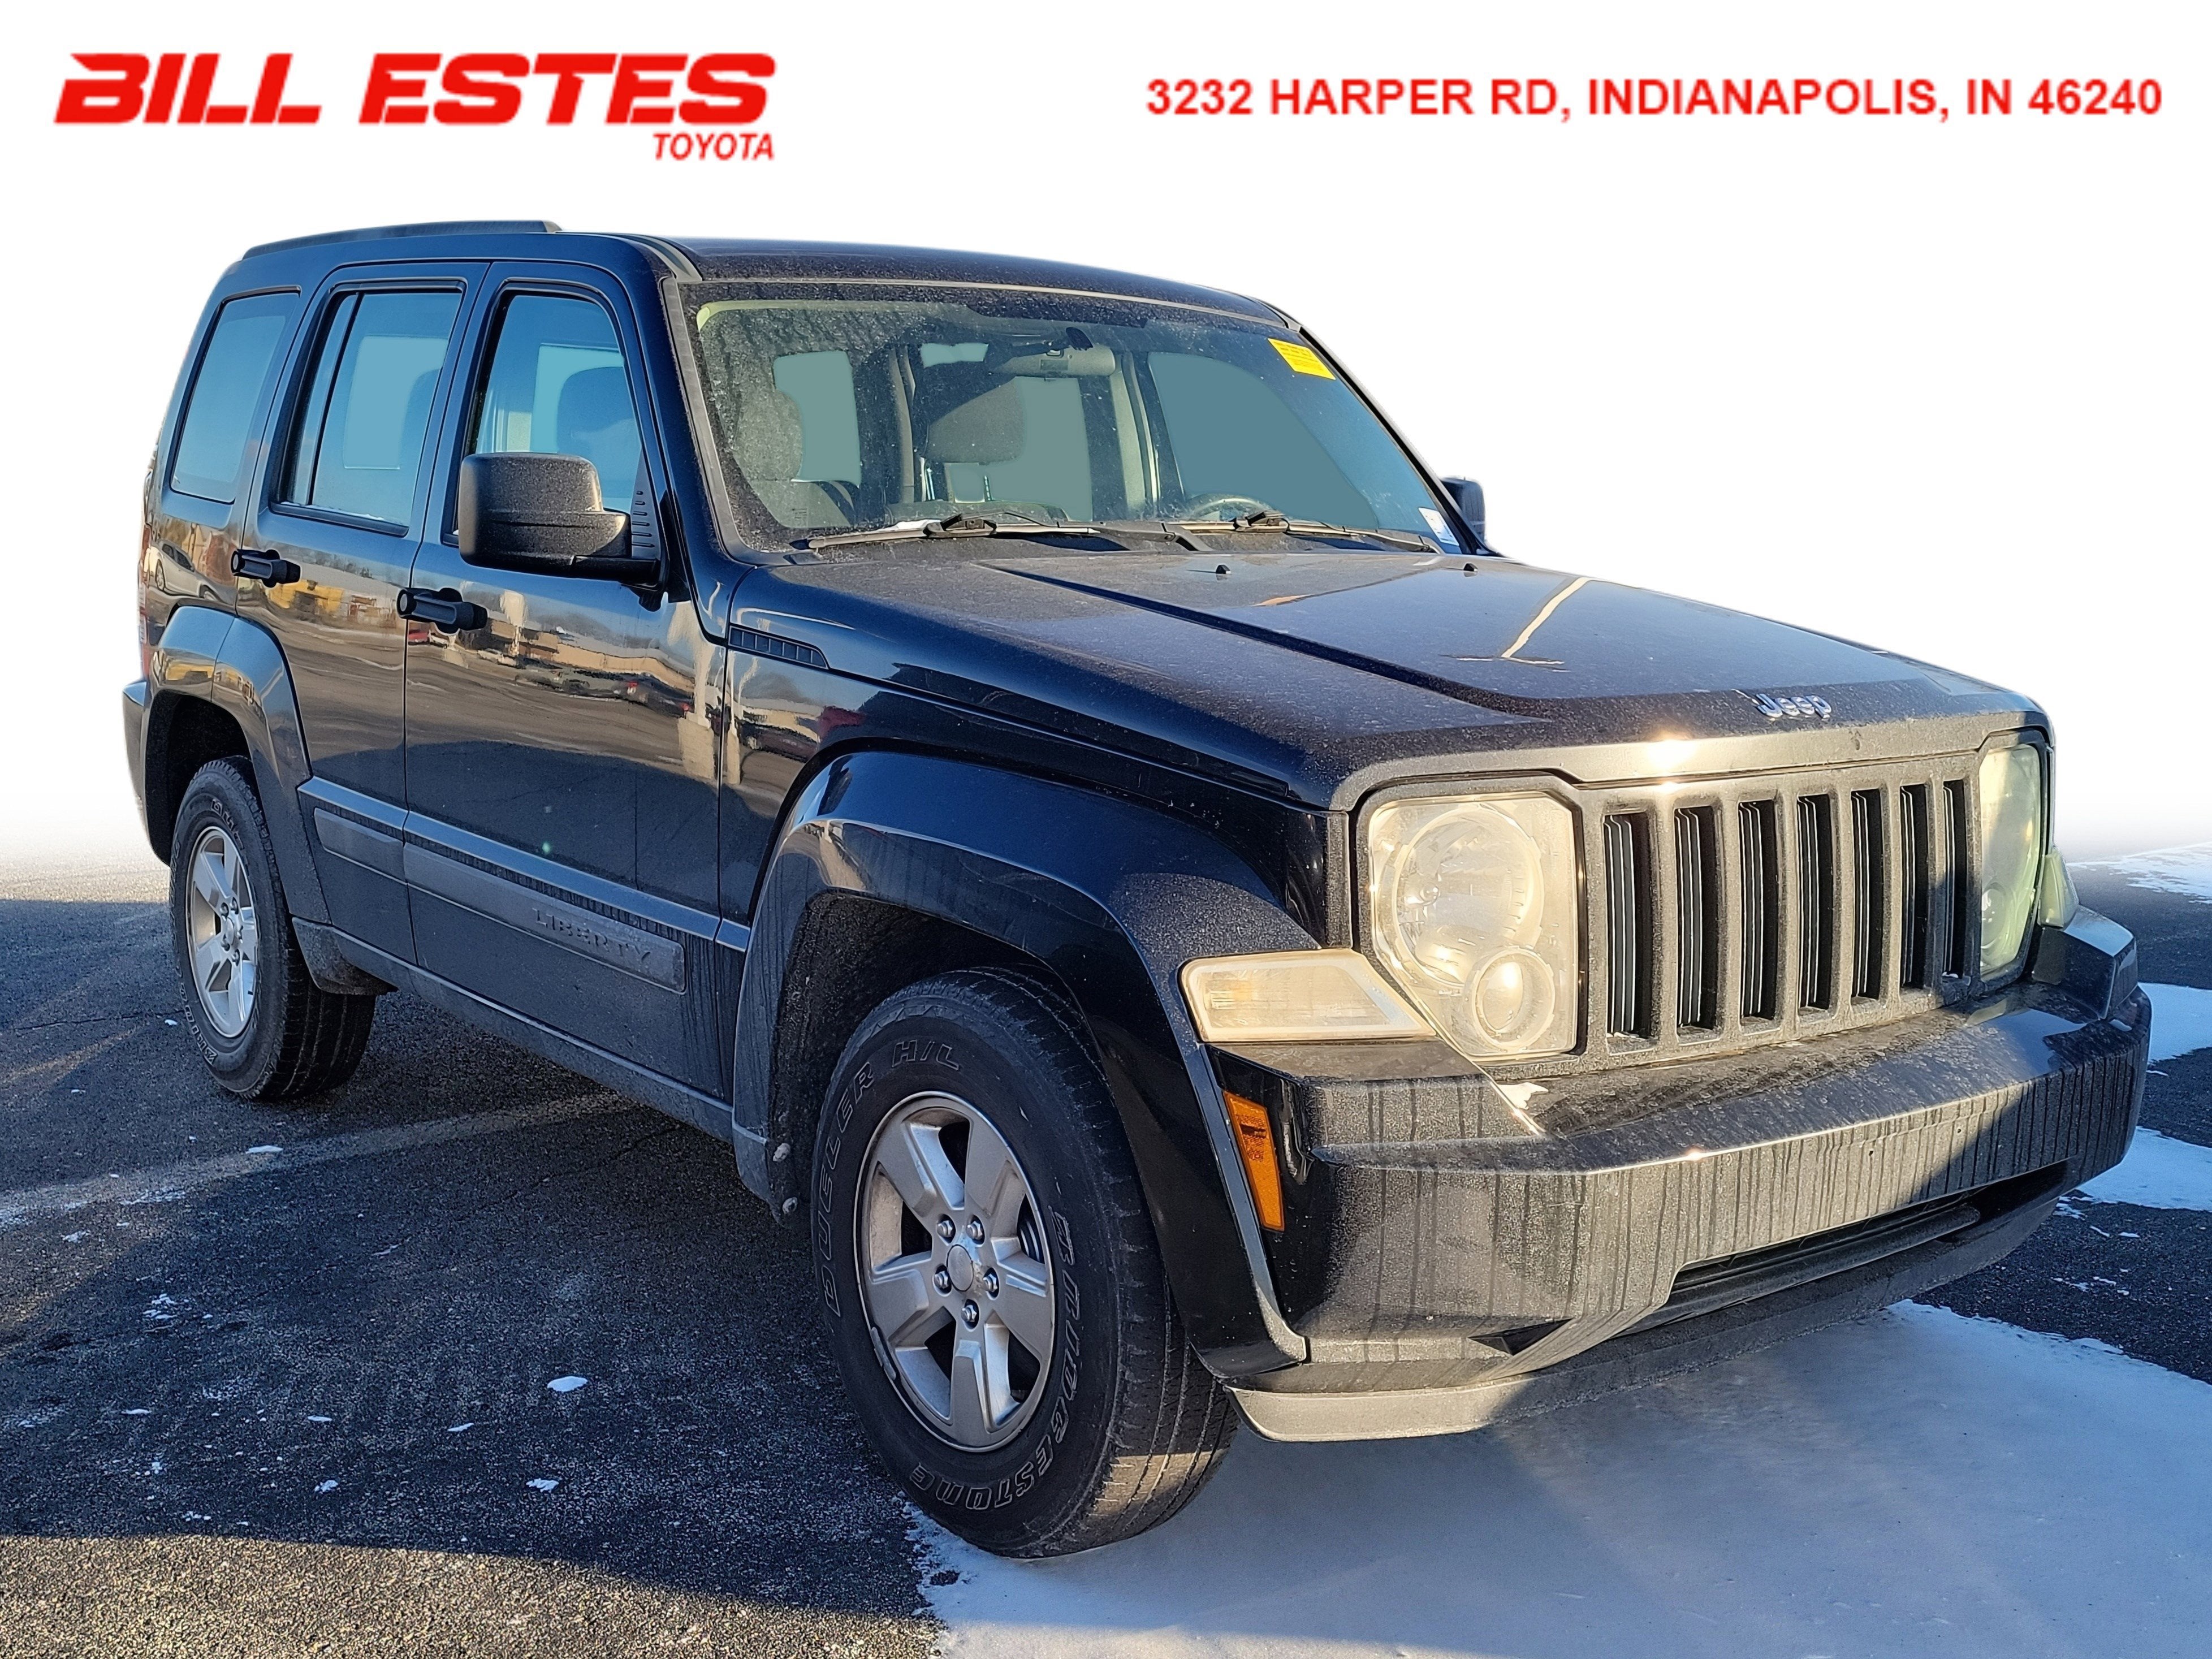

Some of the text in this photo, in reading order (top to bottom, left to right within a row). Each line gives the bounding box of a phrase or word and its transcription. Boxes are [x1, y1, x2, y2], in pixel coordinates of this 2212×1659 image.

[1756, 693, 1832, 721] Jeep
[532, 907, 651, 962] LIBERTY
[818, 1039, 960, 1317] DUELER H/L
[909, 1204, 1081, 1511] BRIDGESTONE
